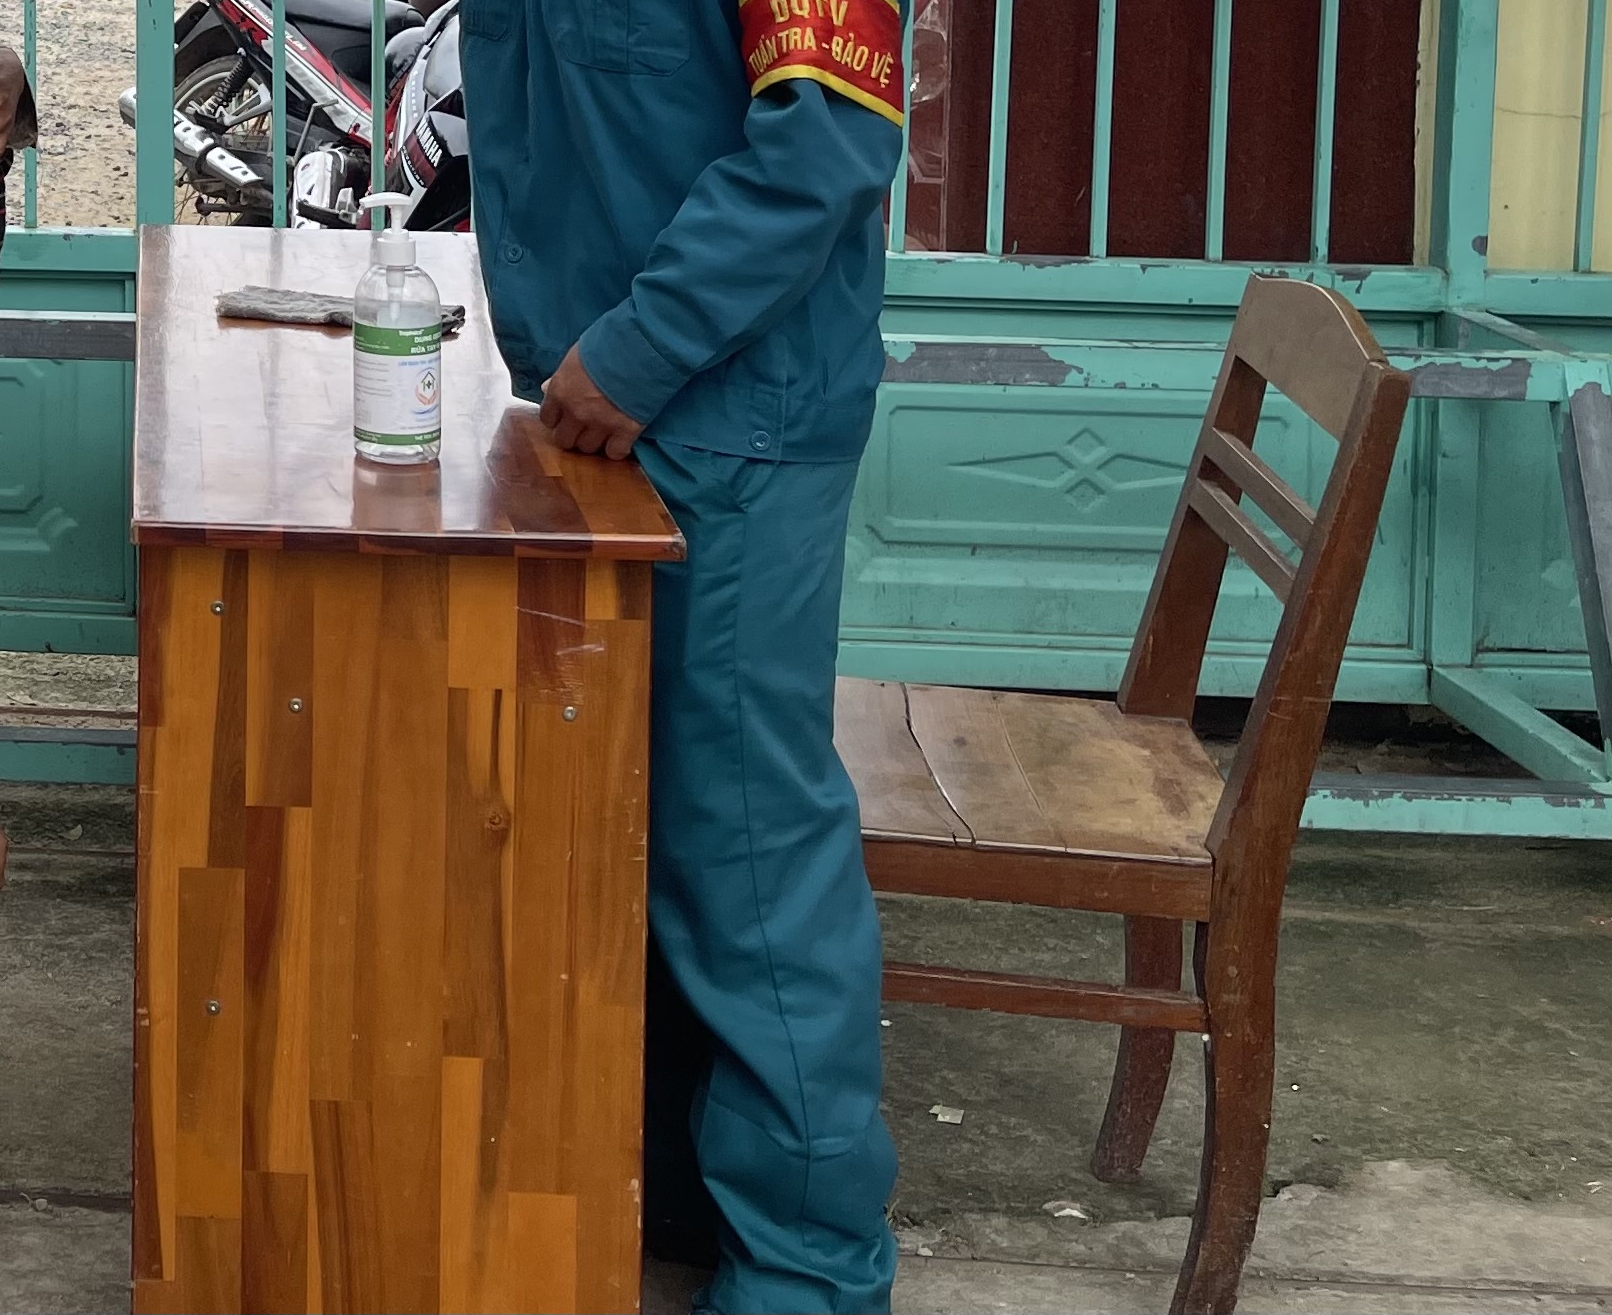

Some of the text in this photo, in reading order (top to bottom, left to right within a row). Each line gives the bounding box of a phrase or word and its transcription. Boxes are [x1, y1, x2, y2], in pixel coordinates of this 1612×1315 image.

[777, 26, 818, 53] TRA
[831, 32, 869, 72] BẢO
[870, 51, 895, 89] VỆ
[415, 113, 443, 168] YAMAHA
